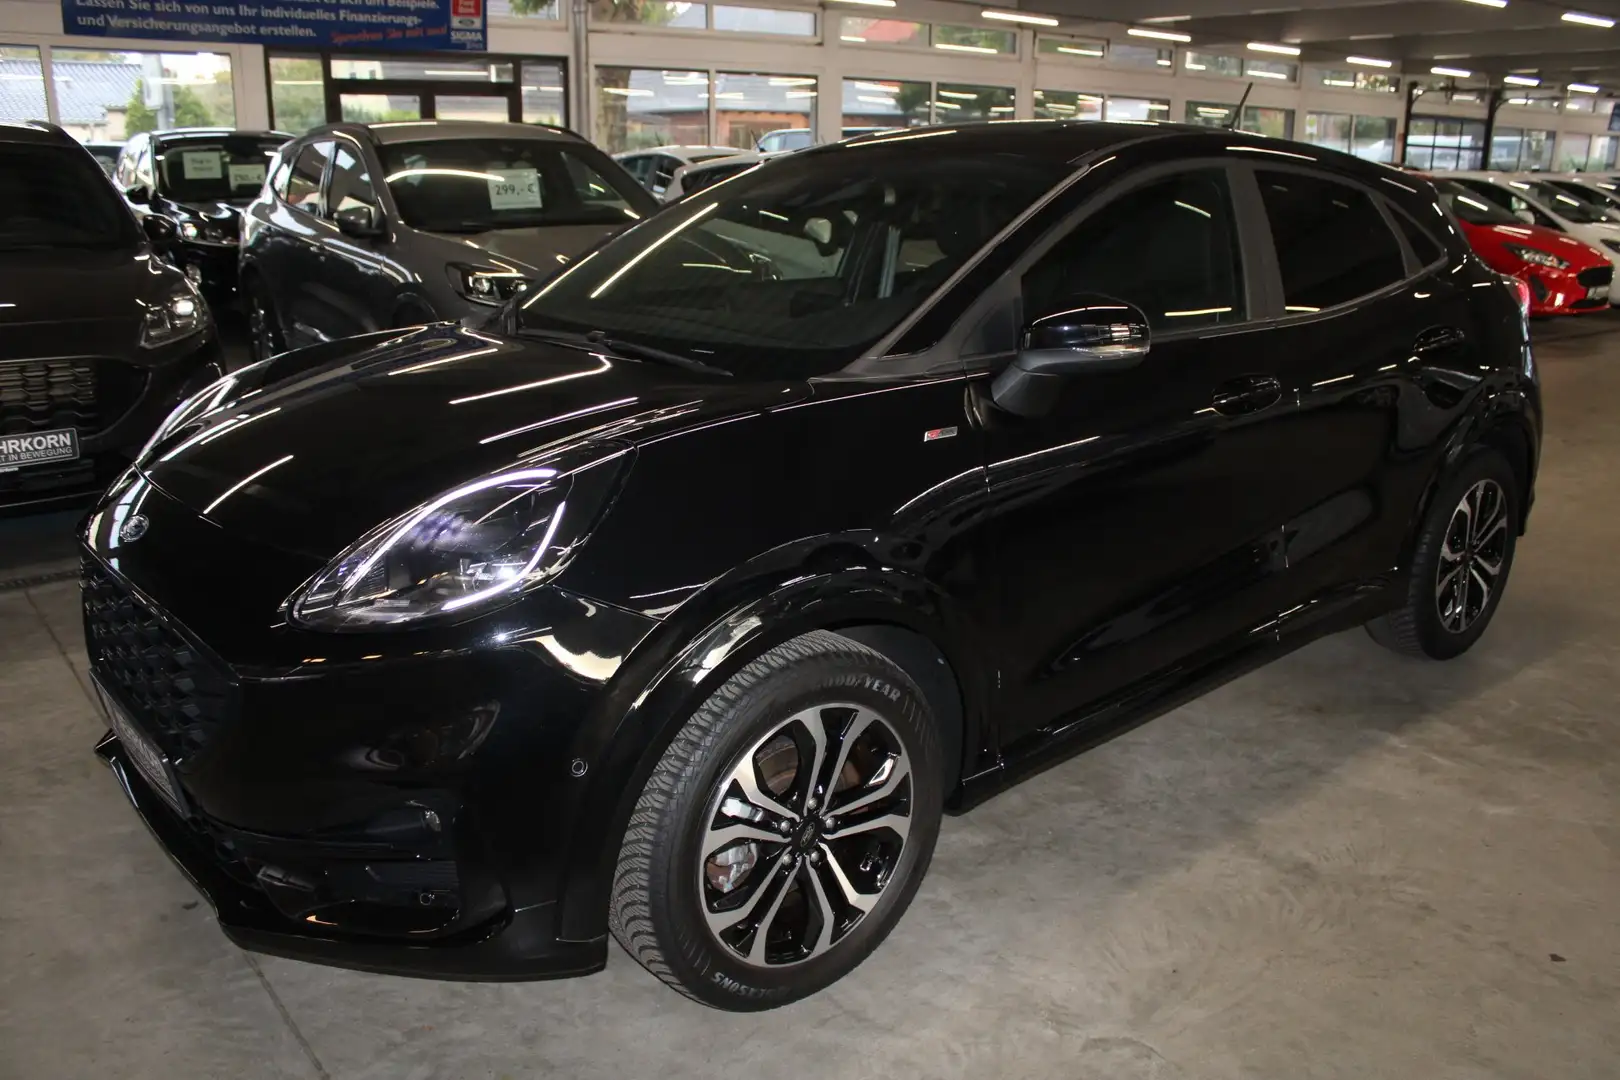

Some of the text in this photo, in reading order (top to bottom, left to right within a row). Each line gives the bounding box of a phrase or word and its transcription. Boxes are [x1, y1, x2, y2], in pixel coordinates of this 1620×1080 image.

[76, 0, 423, 27] Lassen Sie sich von uns Ihr individuelles Finanzierungs-
[76, 13, 317, 37] und Versicherungsangebot erstellen.
[495, 183, 525, 196] 299,-
[8, 453, 19, 462] IN
[20, 446, 73, 460] BEWEGUNG
